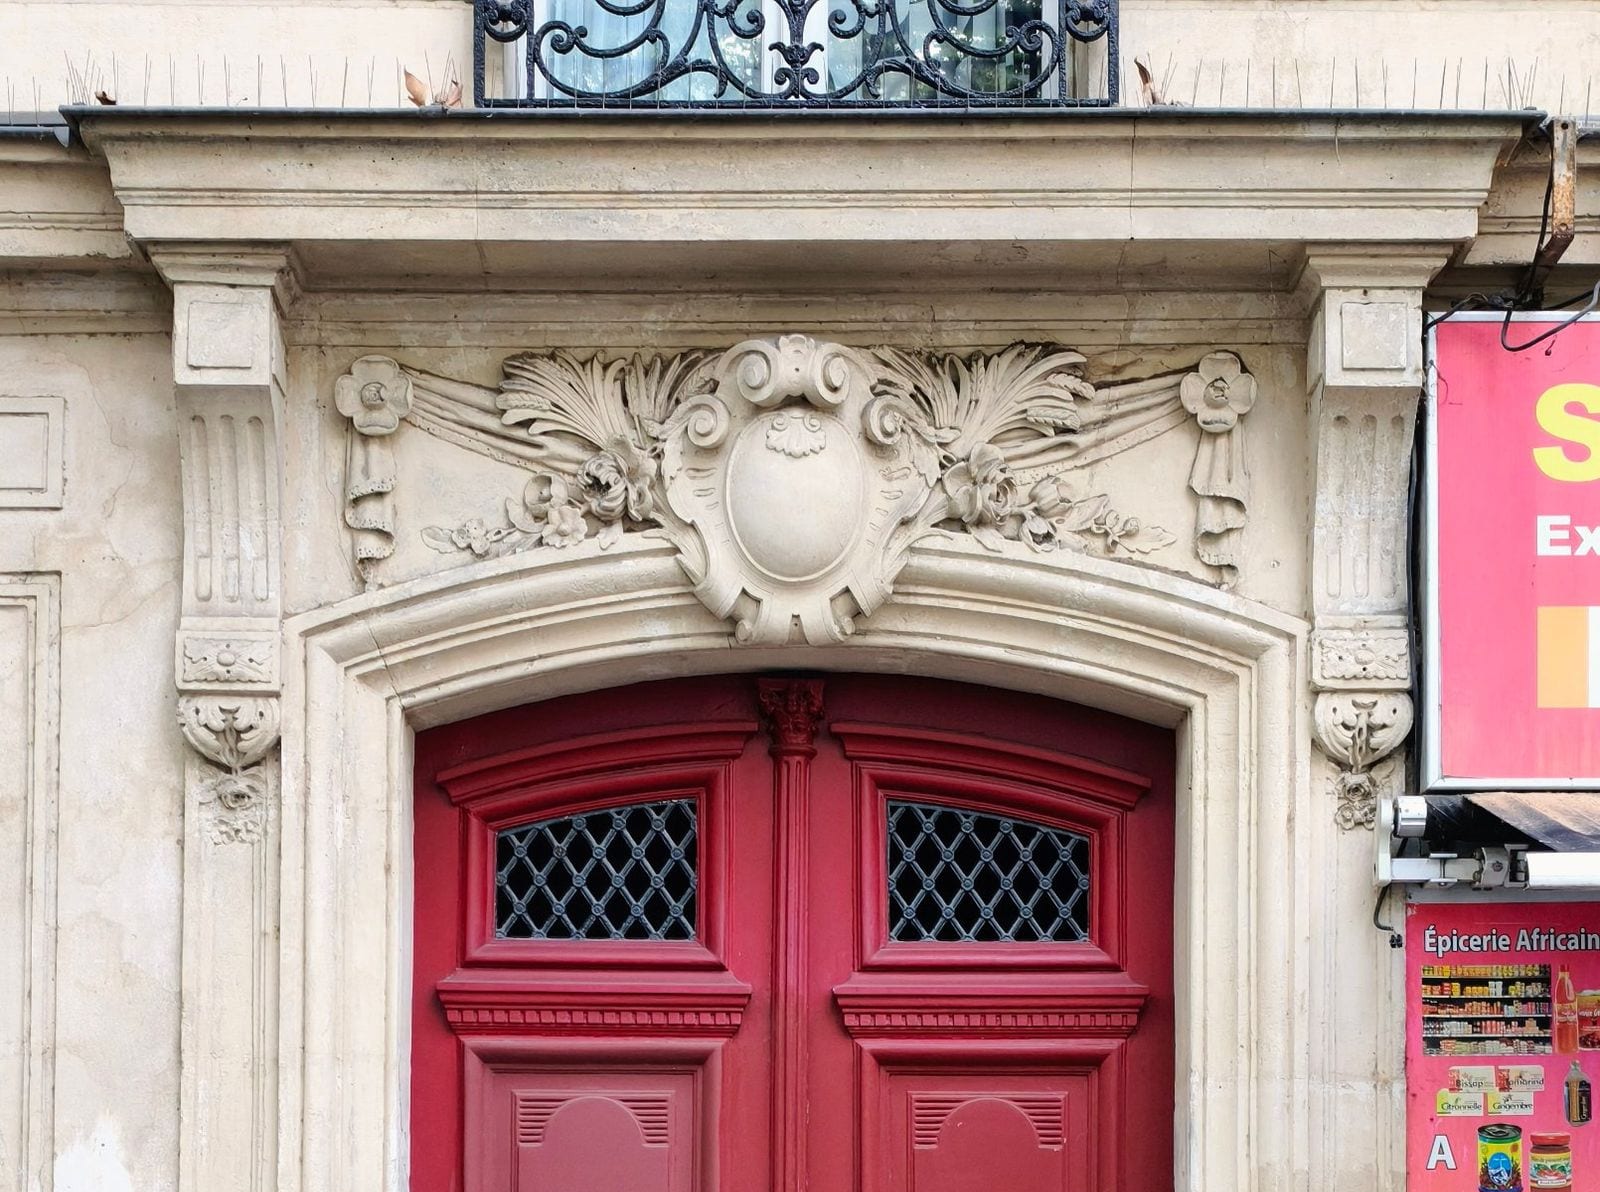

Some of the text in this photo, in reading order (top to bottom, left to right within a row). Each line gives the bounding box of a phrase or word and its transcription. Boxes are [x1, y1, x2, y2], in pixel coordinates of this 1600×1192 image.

[1532, 383, 1600, 482] S
[1536, 515, 1600, 556] Ex
[1423, 925, 1510, 957] Épicerie
